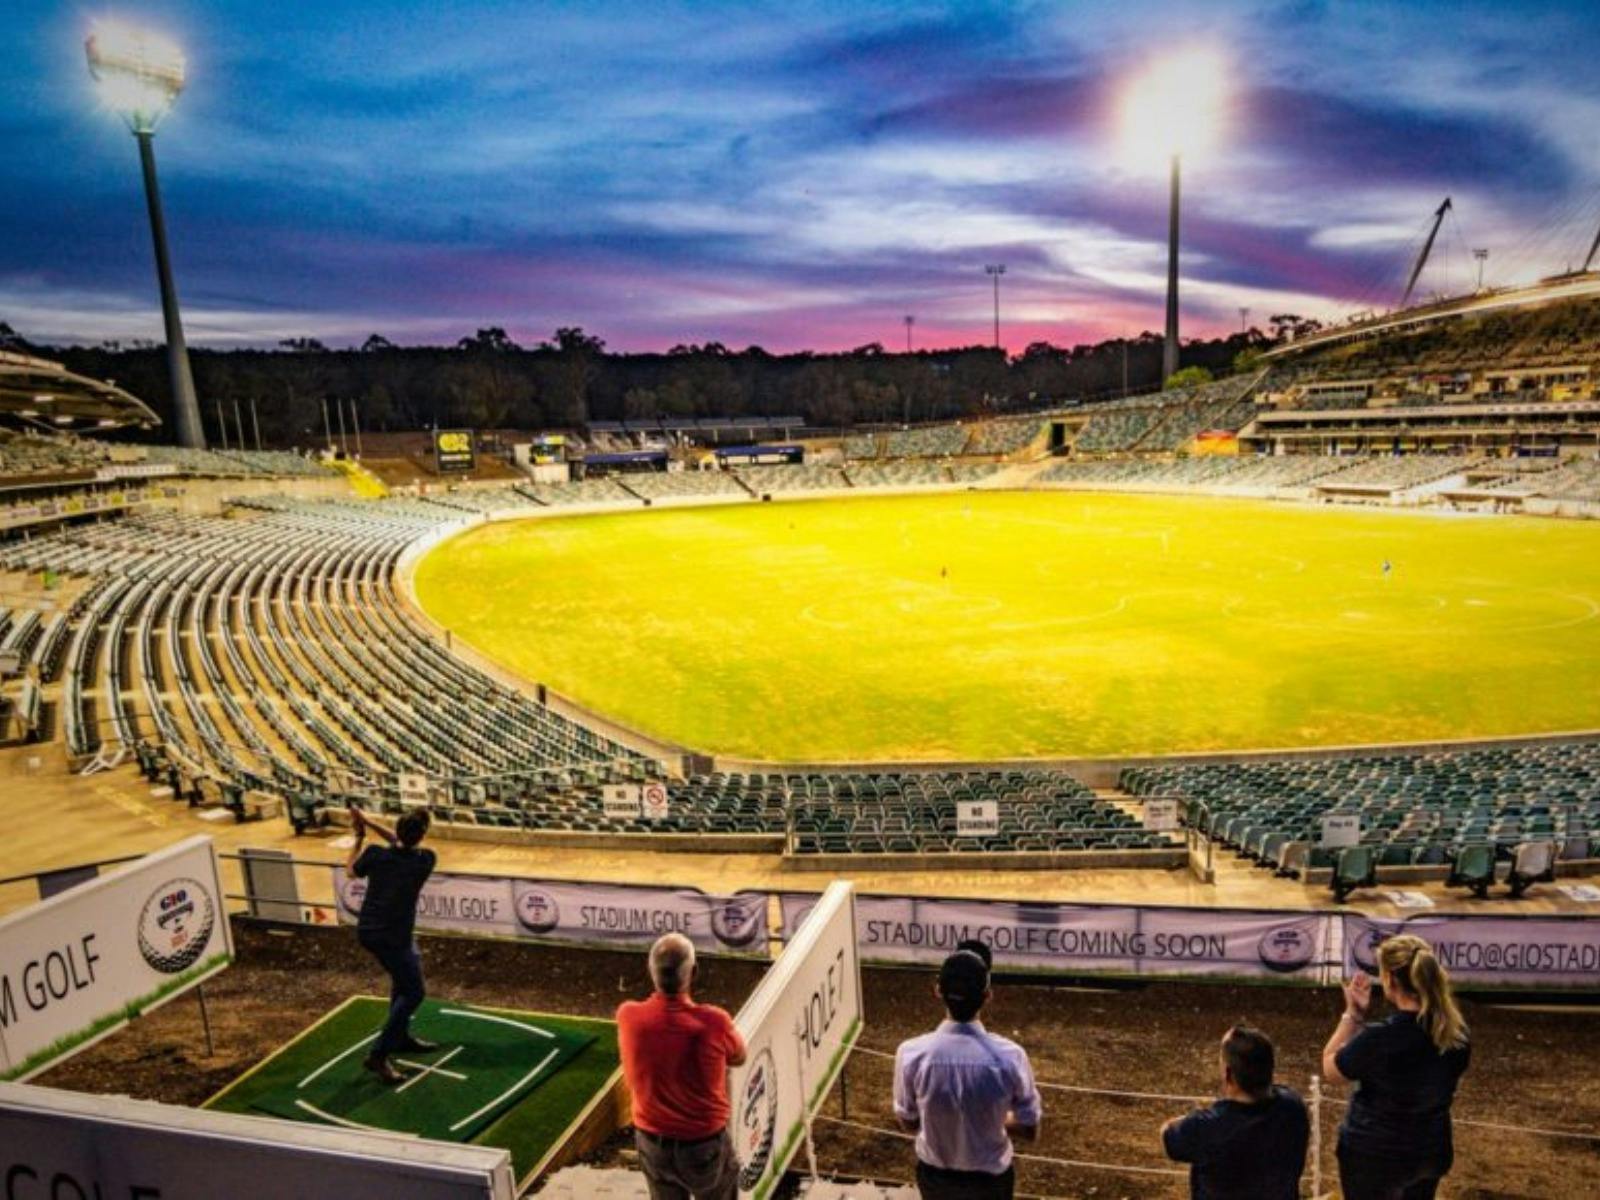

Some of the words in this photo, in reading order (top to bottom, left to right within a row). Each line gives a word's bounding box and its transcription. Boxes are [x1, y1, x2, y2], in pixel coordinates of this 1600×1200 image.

[416, 893, 456, 917] DIUM
[459, 897, 500, 921] GOLF
[580, 905, 648, 931] STADIUM
[652, 910, 693, 934] GOLF
[866, 920, 969, 947] STADIUM
[976, 925, 1038, 951] GOLF
[1045, 928, 1147, 957] COMING
[1154, 932, 1226, 958] SOON
[22, 933, 100, 1012] GOLF
[797, 965, 836, 1062] HOLE
